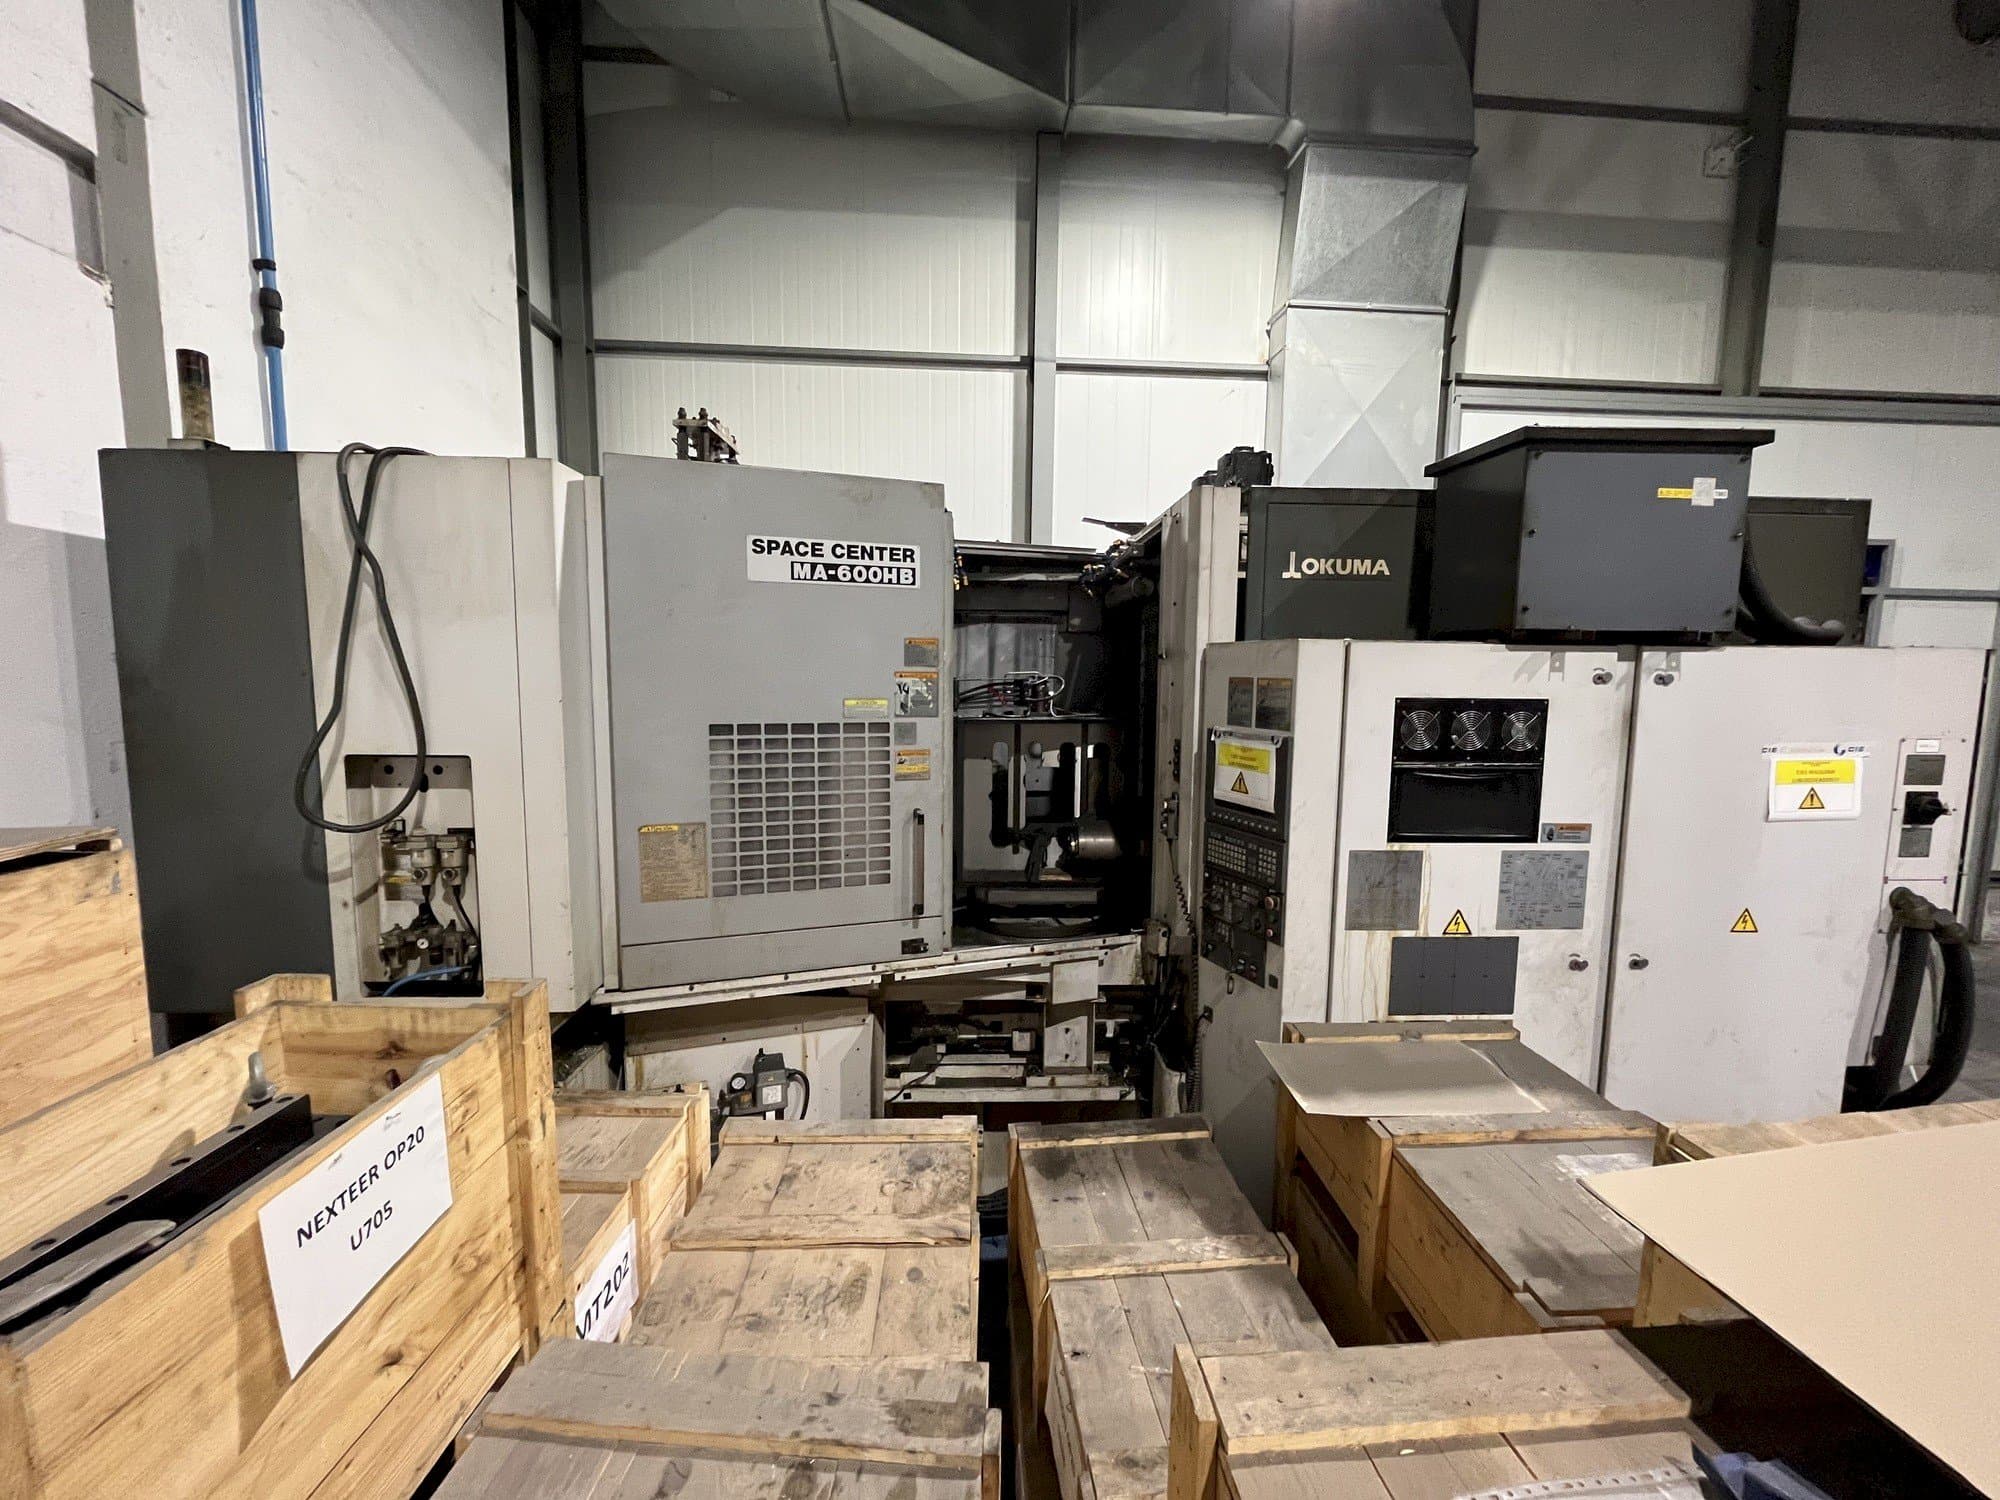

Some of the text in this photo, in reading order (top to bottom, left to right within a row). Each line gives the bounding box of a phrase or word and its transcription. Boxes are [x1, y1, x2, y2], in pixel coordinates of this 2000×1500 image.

[752, 538, 915, 563] SPACE CENTER
[793, 562, 914, 585] MA-600HB
[1301, 557, 1391, 576] OKUMA
[297, 1125, 425, 1248] NEXTEER OP20
[350, 1200, 393, 1251] U705
